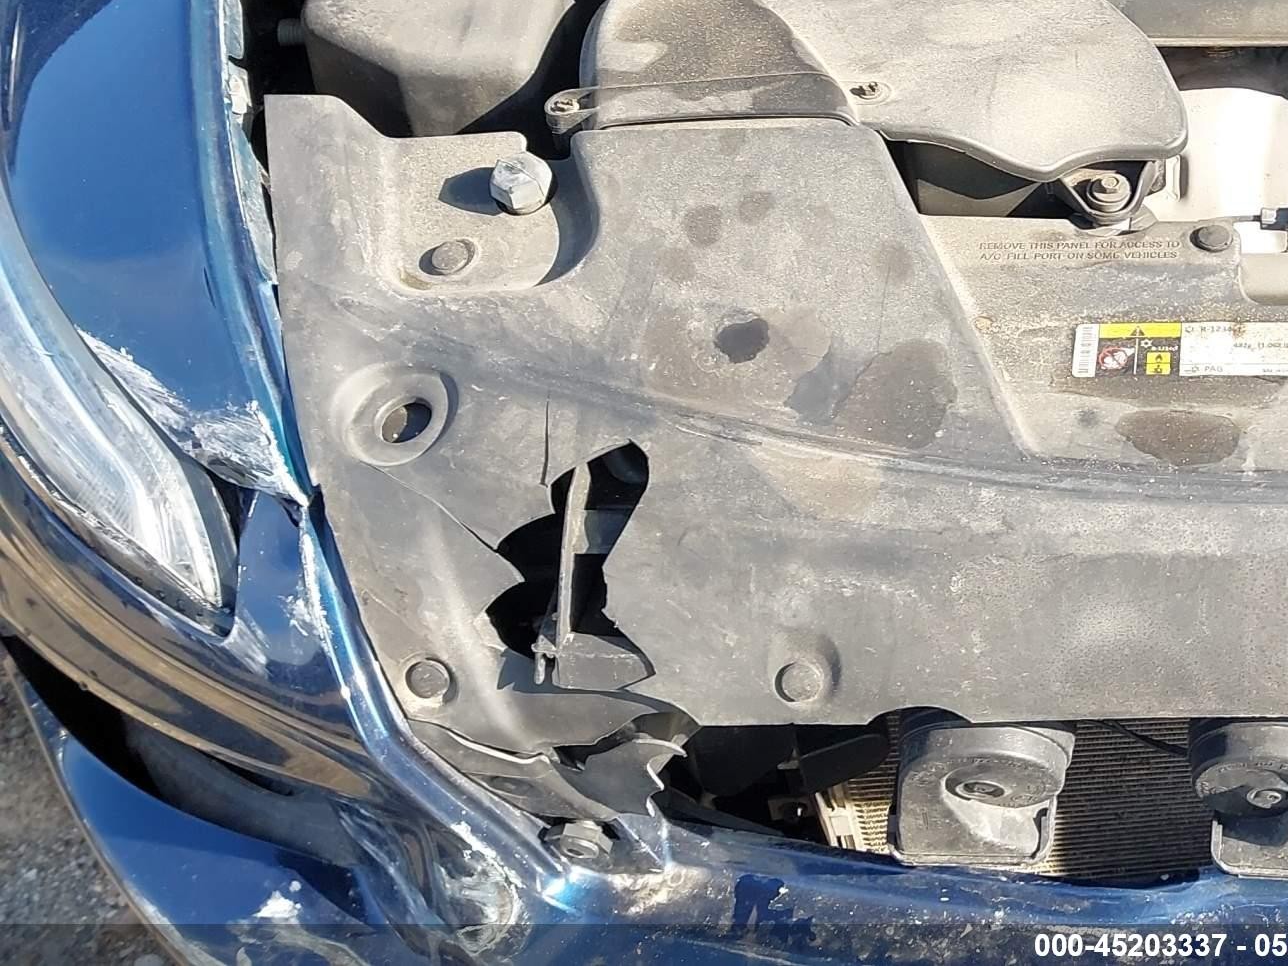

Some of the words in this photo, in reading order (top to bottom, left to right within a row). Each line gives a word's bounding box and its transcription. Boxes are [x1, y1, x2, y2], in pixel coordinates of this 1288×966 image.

[979, 242, 1025, 250] REMOVE
[1030, 242, 1053, 250] THIS
[1056, 241, 1091, 250] PANEL
[1094, 241, 1117, 249] FOR
[1119, 241, 1162, 249] ACCESS
[1166, 240, 1180, 249] TO
[1007, 251, 1029, 260] FILL
[1034, 251, 1064, 260] PORT
[1067, 251, 1085, 260] ON
[1087, 251, 1121, 259] SOME
[1124, 251, 1178, 259] VEHICLES
